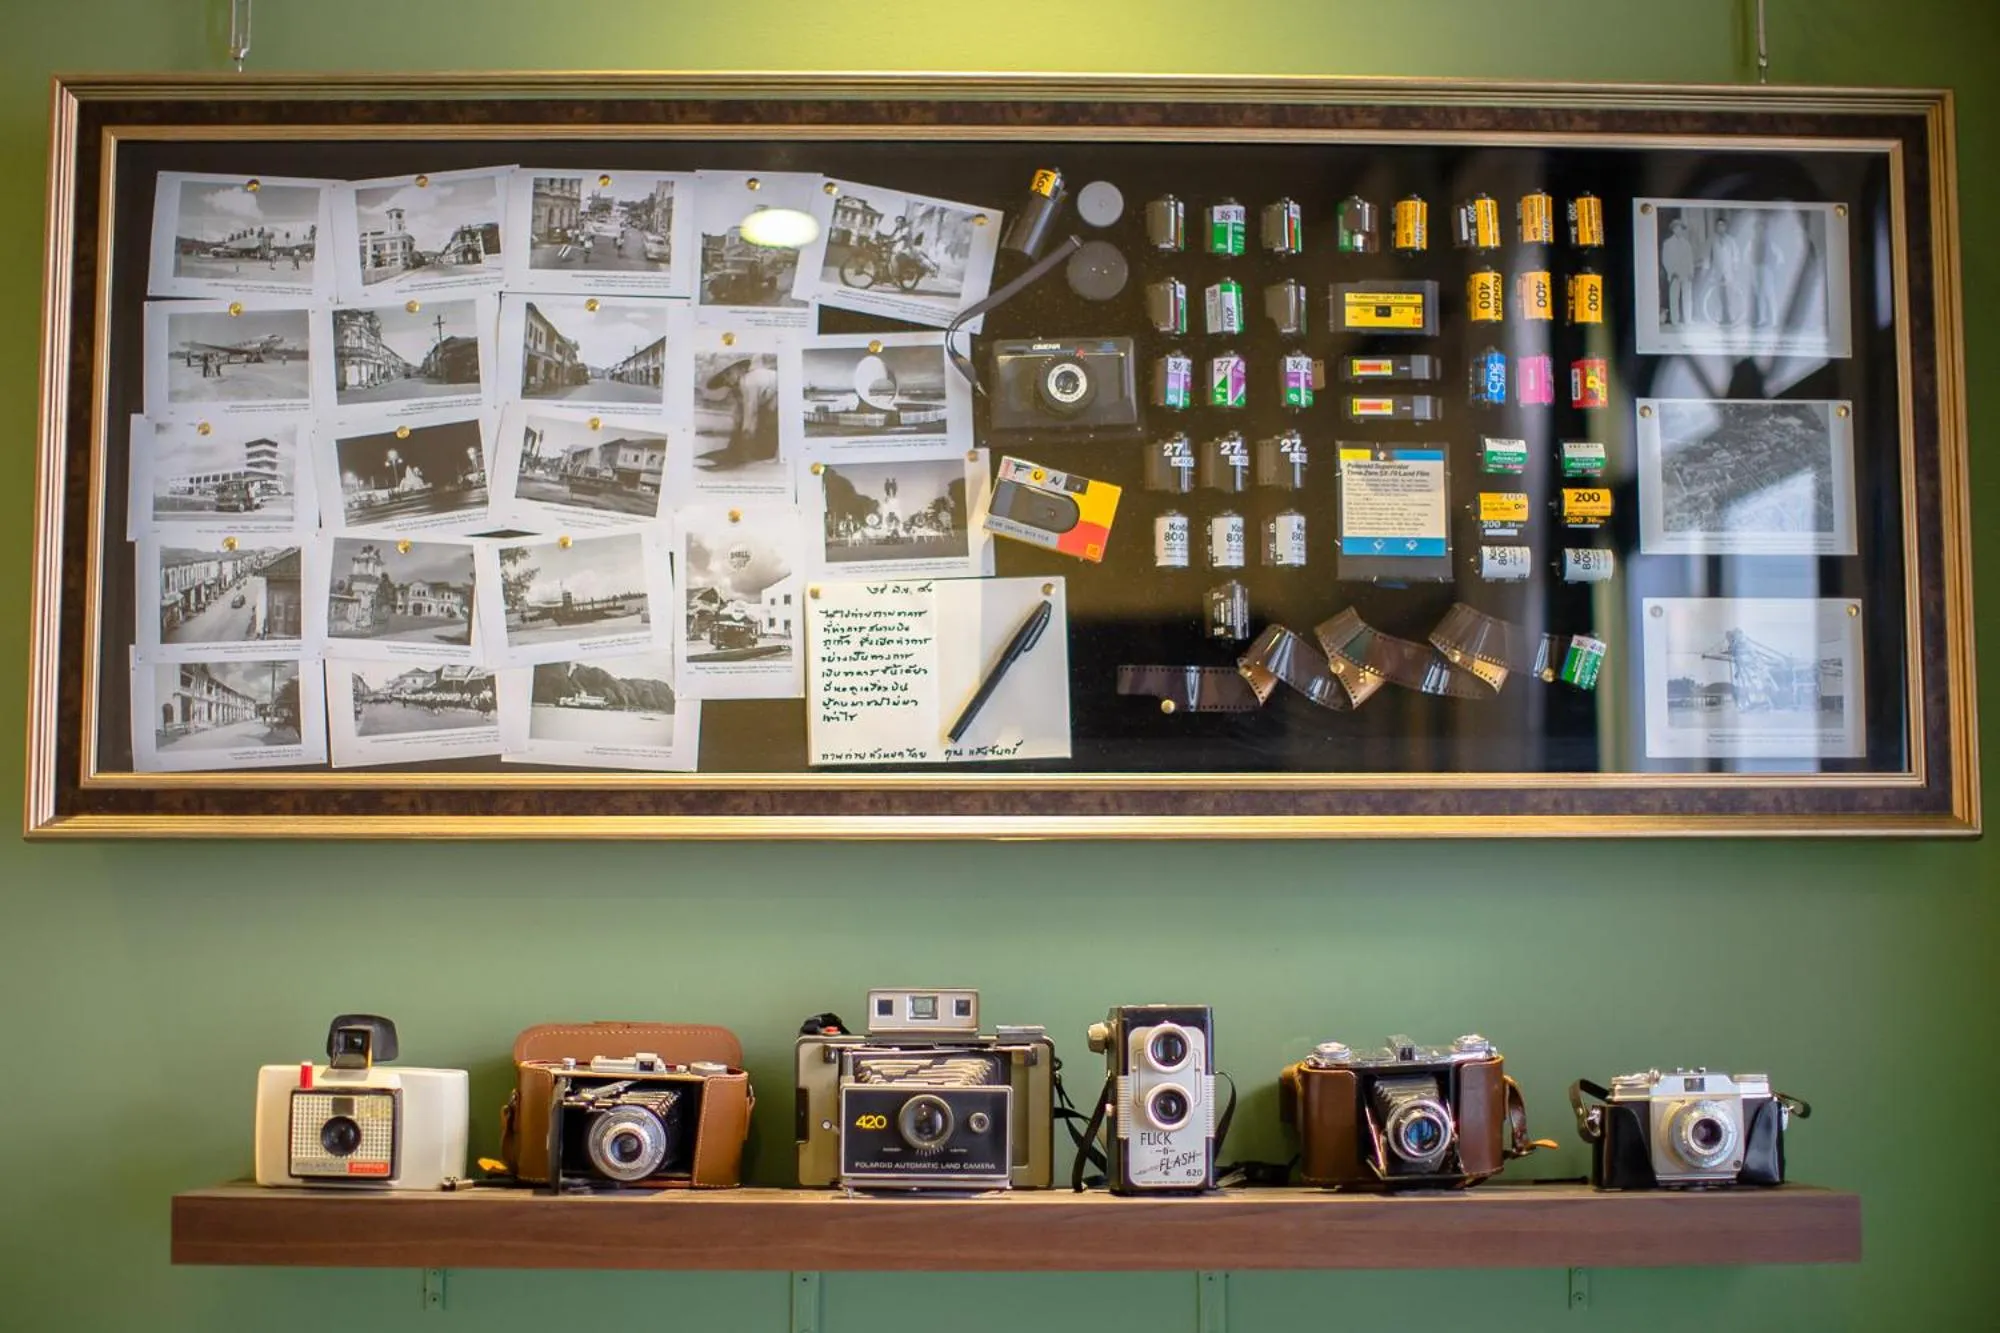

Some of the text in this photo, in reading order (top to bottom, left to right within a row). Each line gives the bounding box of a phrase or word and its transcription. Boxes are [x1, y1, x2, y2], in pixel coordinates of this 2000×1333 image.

[1478, 281, 1491, 309] 400
[1493, 274, 1502, 318] Kodak
[1535, 280, 1547, 308] 400
[1587, 283, 1599, 312] 400
[1215, 359, 1232, 372] 27
[1163, 442, 1184, 457] 27
[1220, 441, 1242, 456] 27
[1280, 438, 1302, 453] 27
[1573, 491, 1601, 503] 200
[1164, 532, 1185, 542] 800
[855, 1115, 888, 1129] 420
[1140, 1131, 1173, 1146] FLICK
[854, 1161, 996, 1170] POLAROID AUTOMATIC LAND CAMERA
[1159, 1150, 1197, 1172] FLASH
[1186, 1168, 1203, 1177] 620
